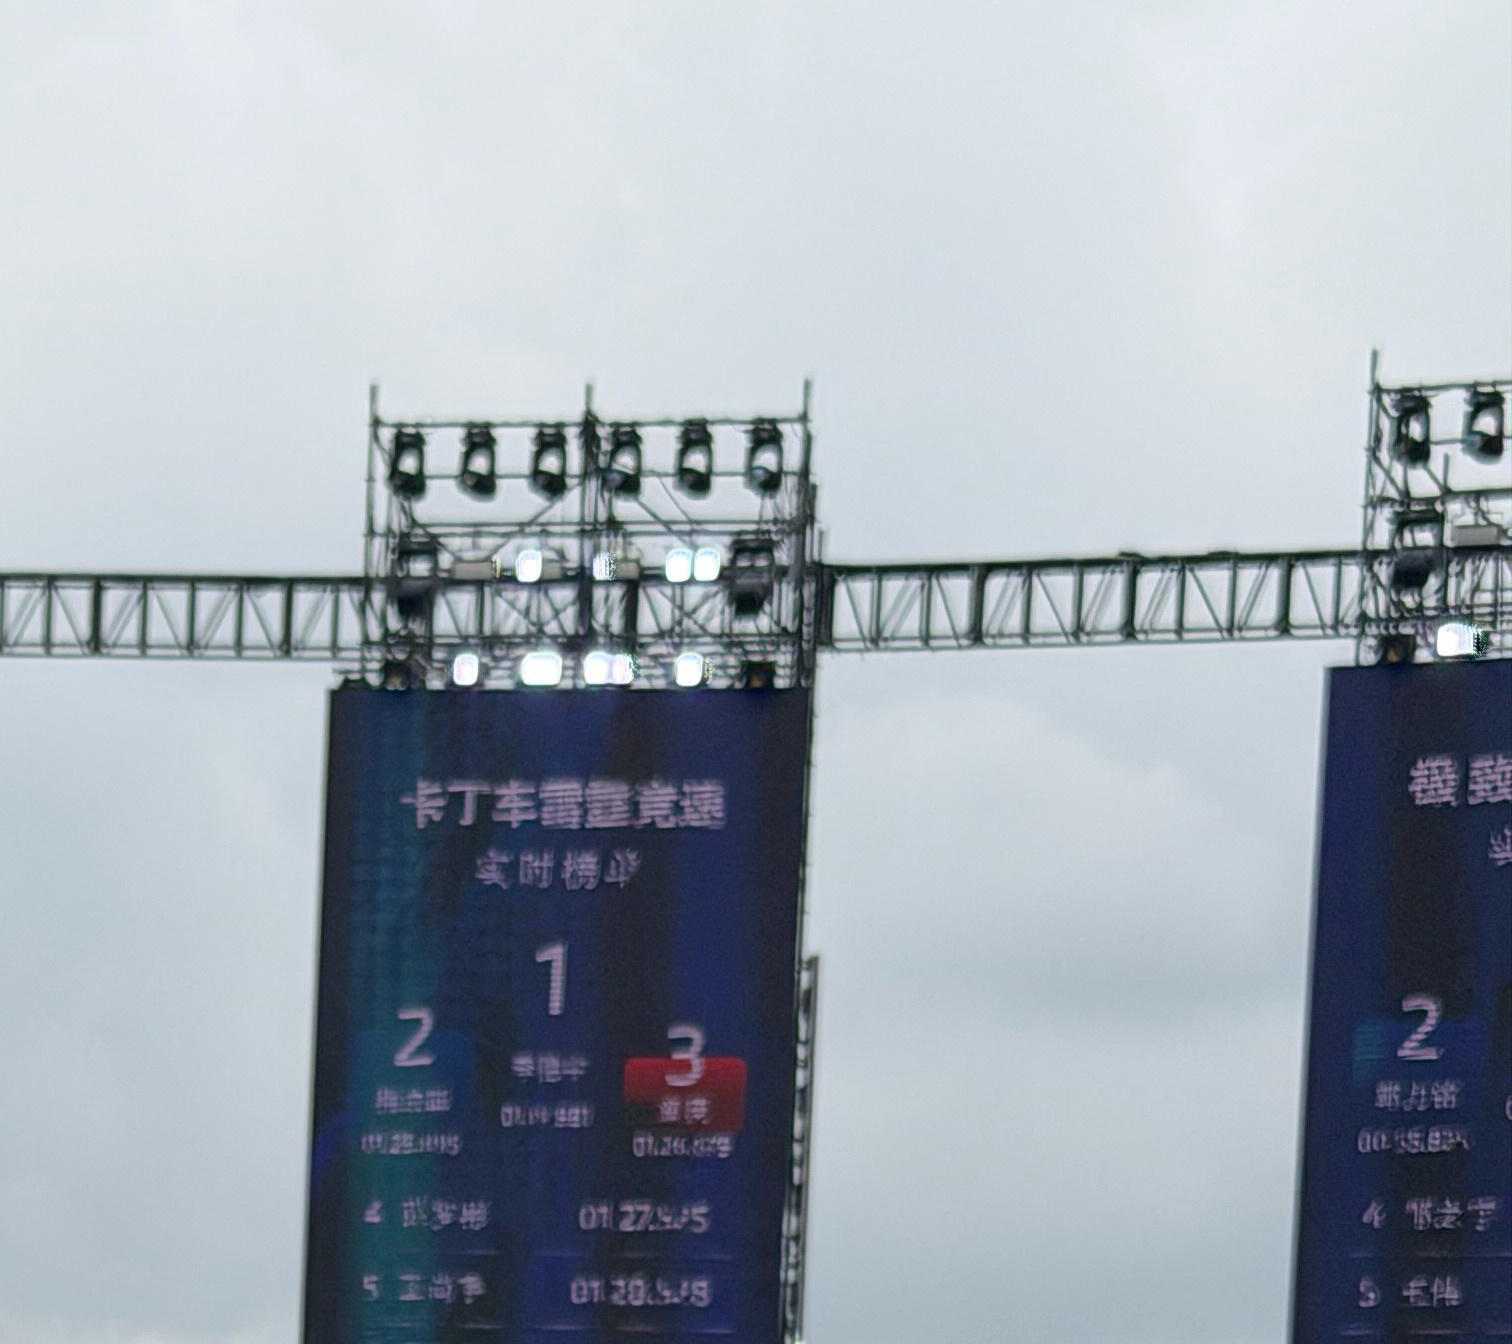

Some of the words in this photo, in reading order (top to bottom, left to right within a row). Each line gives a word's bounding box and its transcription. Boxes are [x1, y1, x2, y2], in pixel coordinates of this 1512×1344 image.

[535, 939, 568, 1016] 1
[393, 1006, 436, 1067] 2
[665, 1022, 706, 1087] 3
[1397, 995, 1444, 1061] 2
[1362, 1199, 1387, 1229] 4
[363, 1275, 379, 1300] 5
[1359, 1275, 1381, 1308] 5
